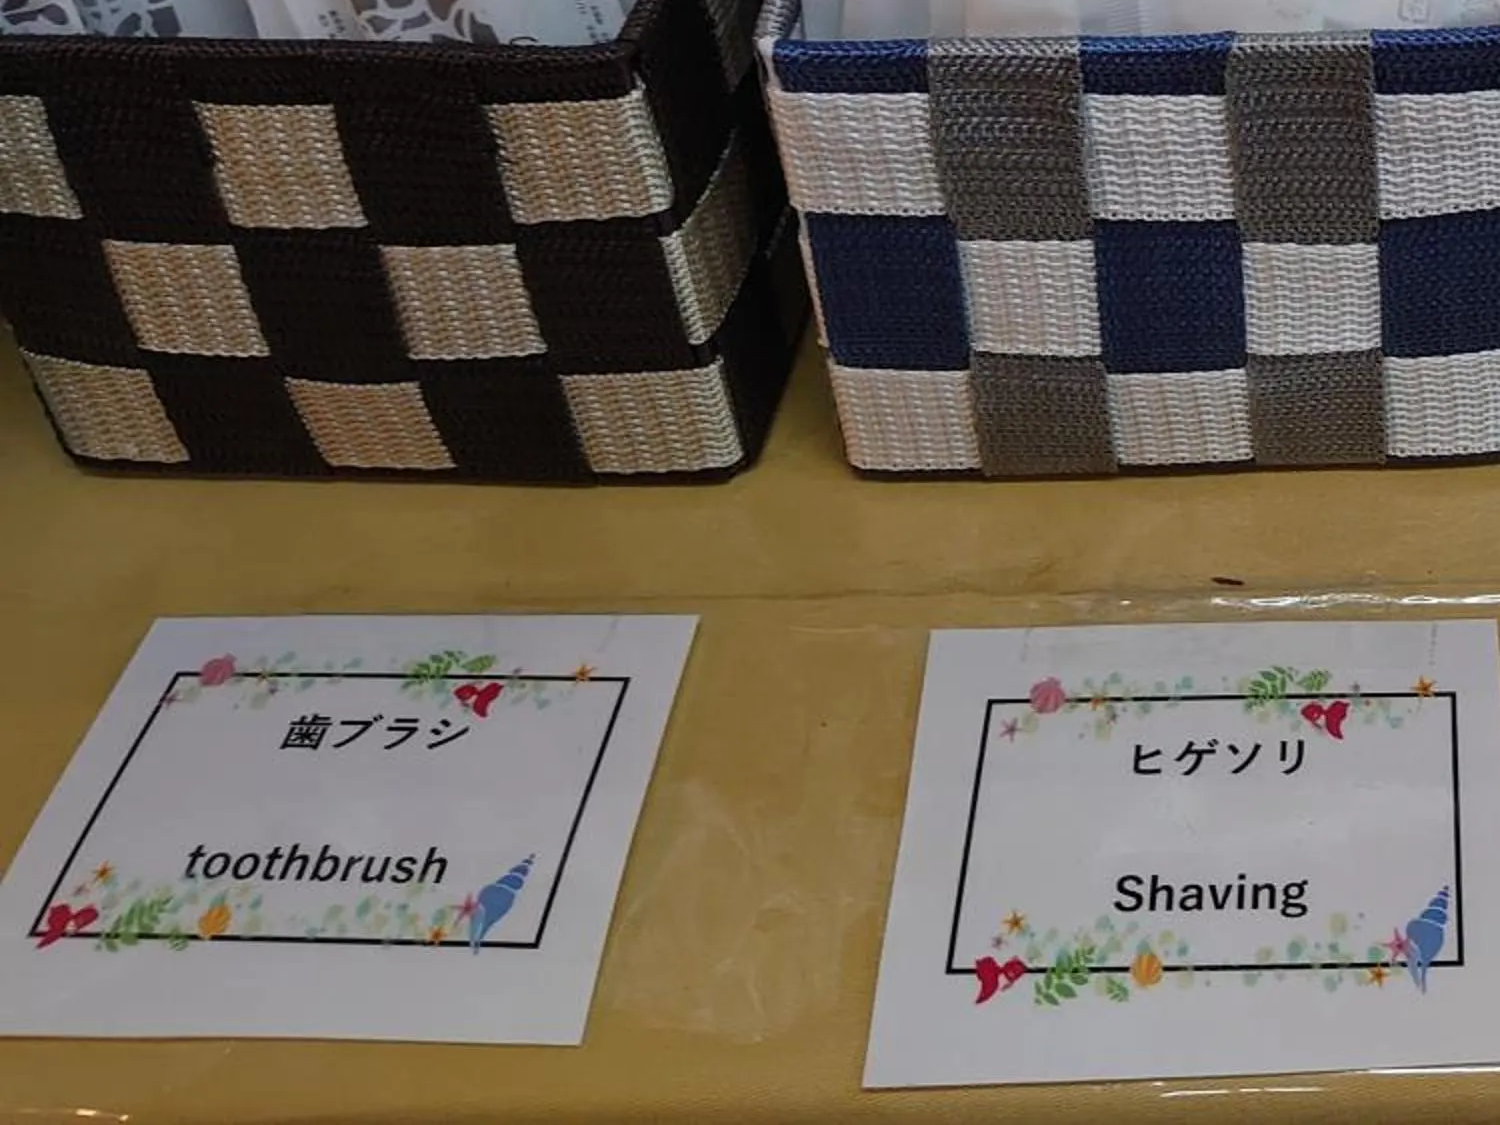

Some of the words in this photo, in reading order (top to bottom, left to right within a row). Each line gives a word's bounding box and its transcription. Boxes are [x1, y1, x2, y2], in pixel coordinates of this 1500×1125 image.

[280, 713, 471, 751] 歯ブラシ
[1132, 738, 1306, 776] ヒゲソリ
[184, 843, 449, 885] toothbrush
[1113, 873, 1309, 918] Shaving
